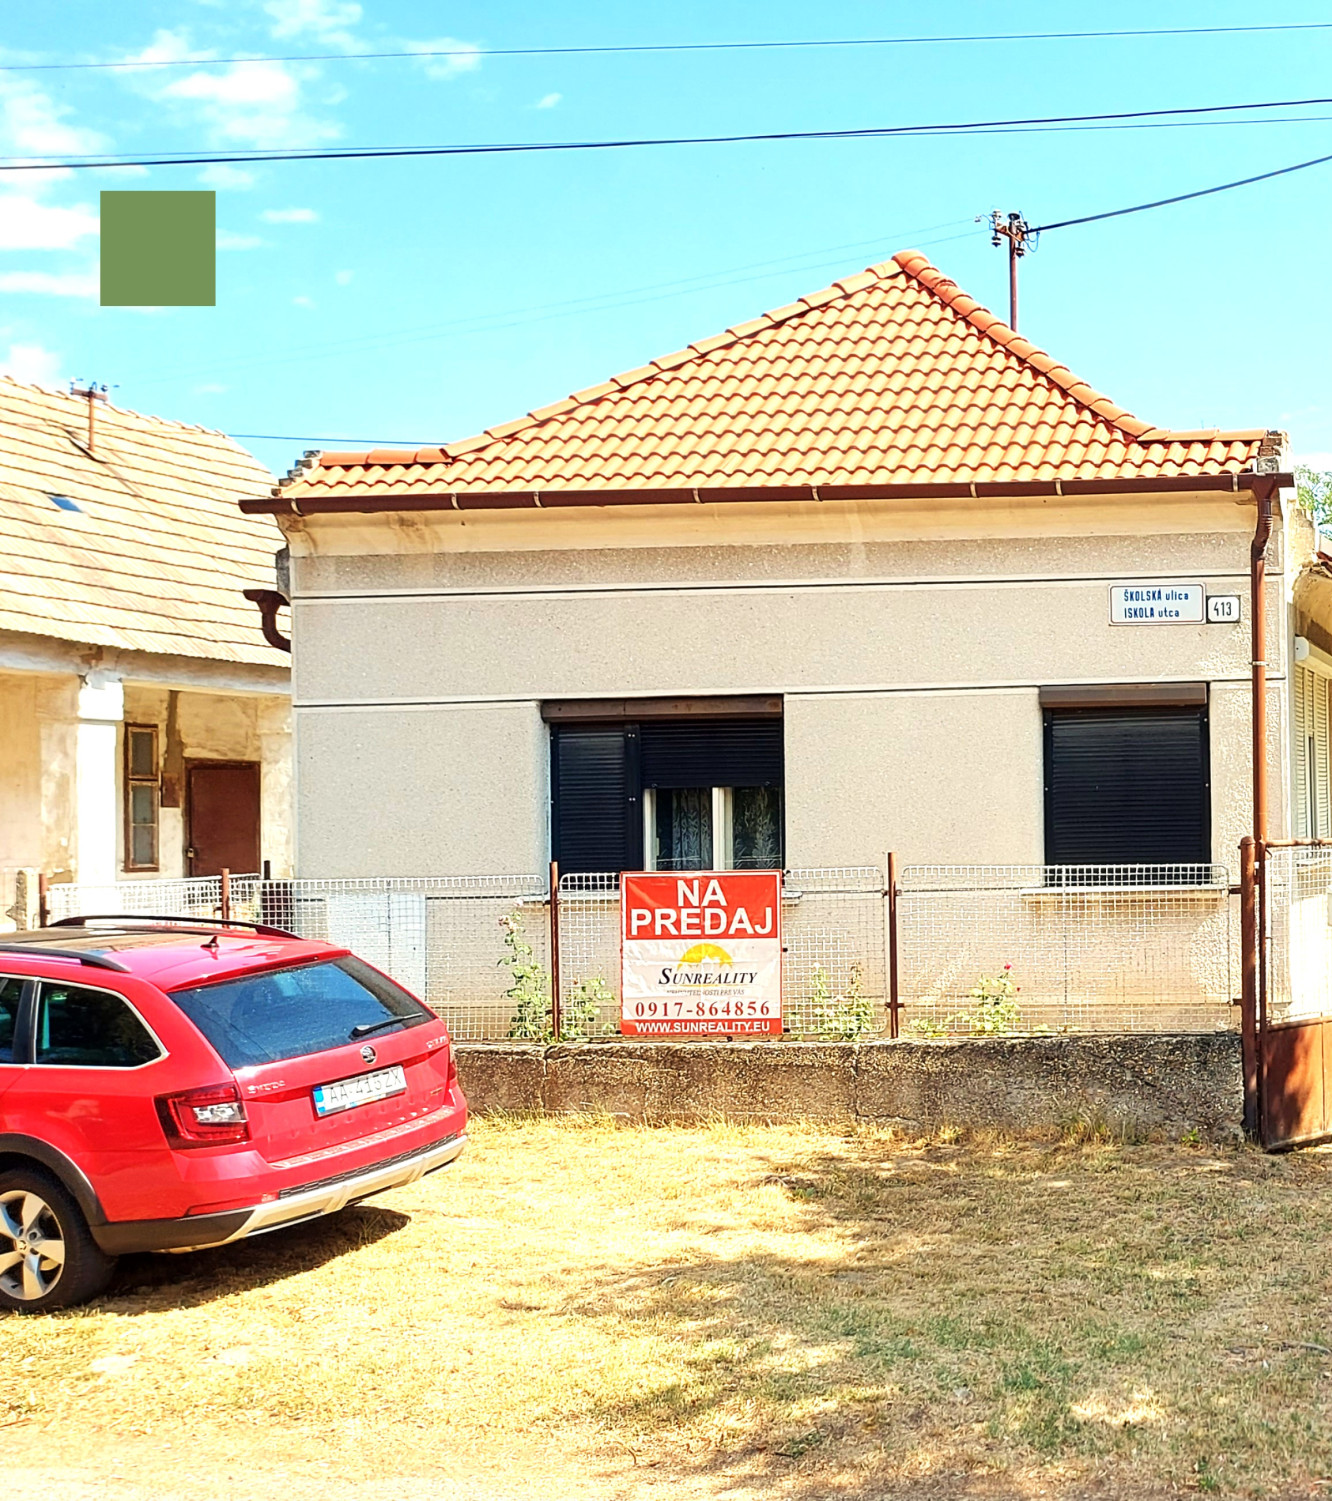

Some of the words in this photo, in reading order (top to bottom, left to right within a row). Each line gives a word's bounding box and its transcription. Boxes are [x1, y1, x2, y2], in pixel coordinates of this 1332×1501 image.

[1124, 588, 1162, 602] ŠKOLSKÁ
[1165, 589, 1189, 600] ulica
[1124, 607, 1154, 619] ISKOLA
[1158, 607, 1180, 618] utca
[1213, 602, 1232, 616] 413
[677, 879, 727, 907] NA
[630, 907, 773, 936] PREDAJ
[658, 968, 758, 985] SUNREALITY
[635, 1000, 770, 1017] 0917-864856
[635, 1021, 770, 1033] WWW.SUNREALITY.EU
